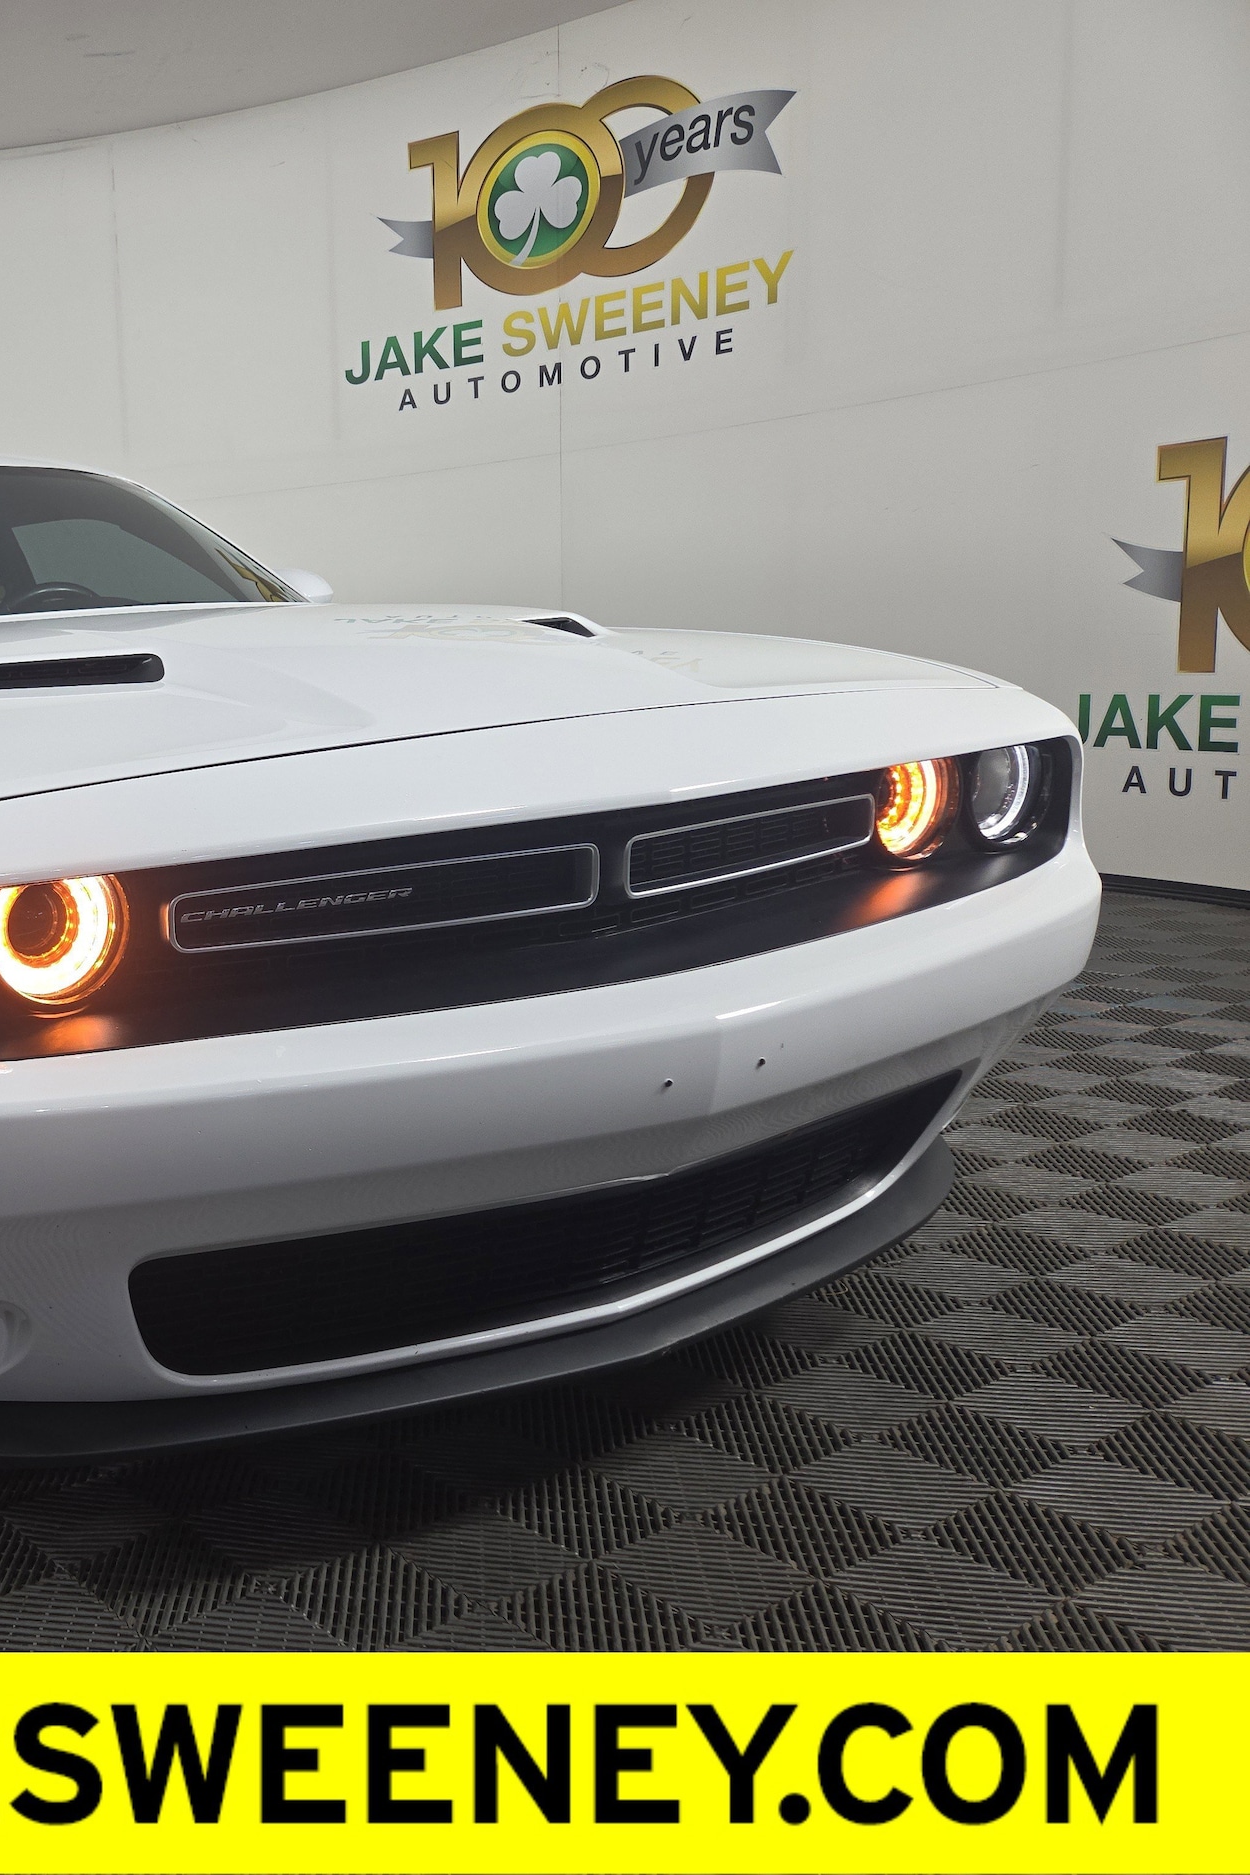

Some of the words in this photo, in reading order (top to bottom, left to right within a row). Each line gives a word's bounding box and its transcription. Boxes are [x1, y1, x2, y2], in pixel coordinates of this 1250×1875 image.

[633, 102, 756, 186] years
[406, 75, 720, 312] 100
[345, 319, 484, 386] JAKE
[502, 250, 794, 357] SWEENEY
[398, 327, 734, 412] AUTOMOTIVE
[180, 886, 413, 924] CHALLENGER
